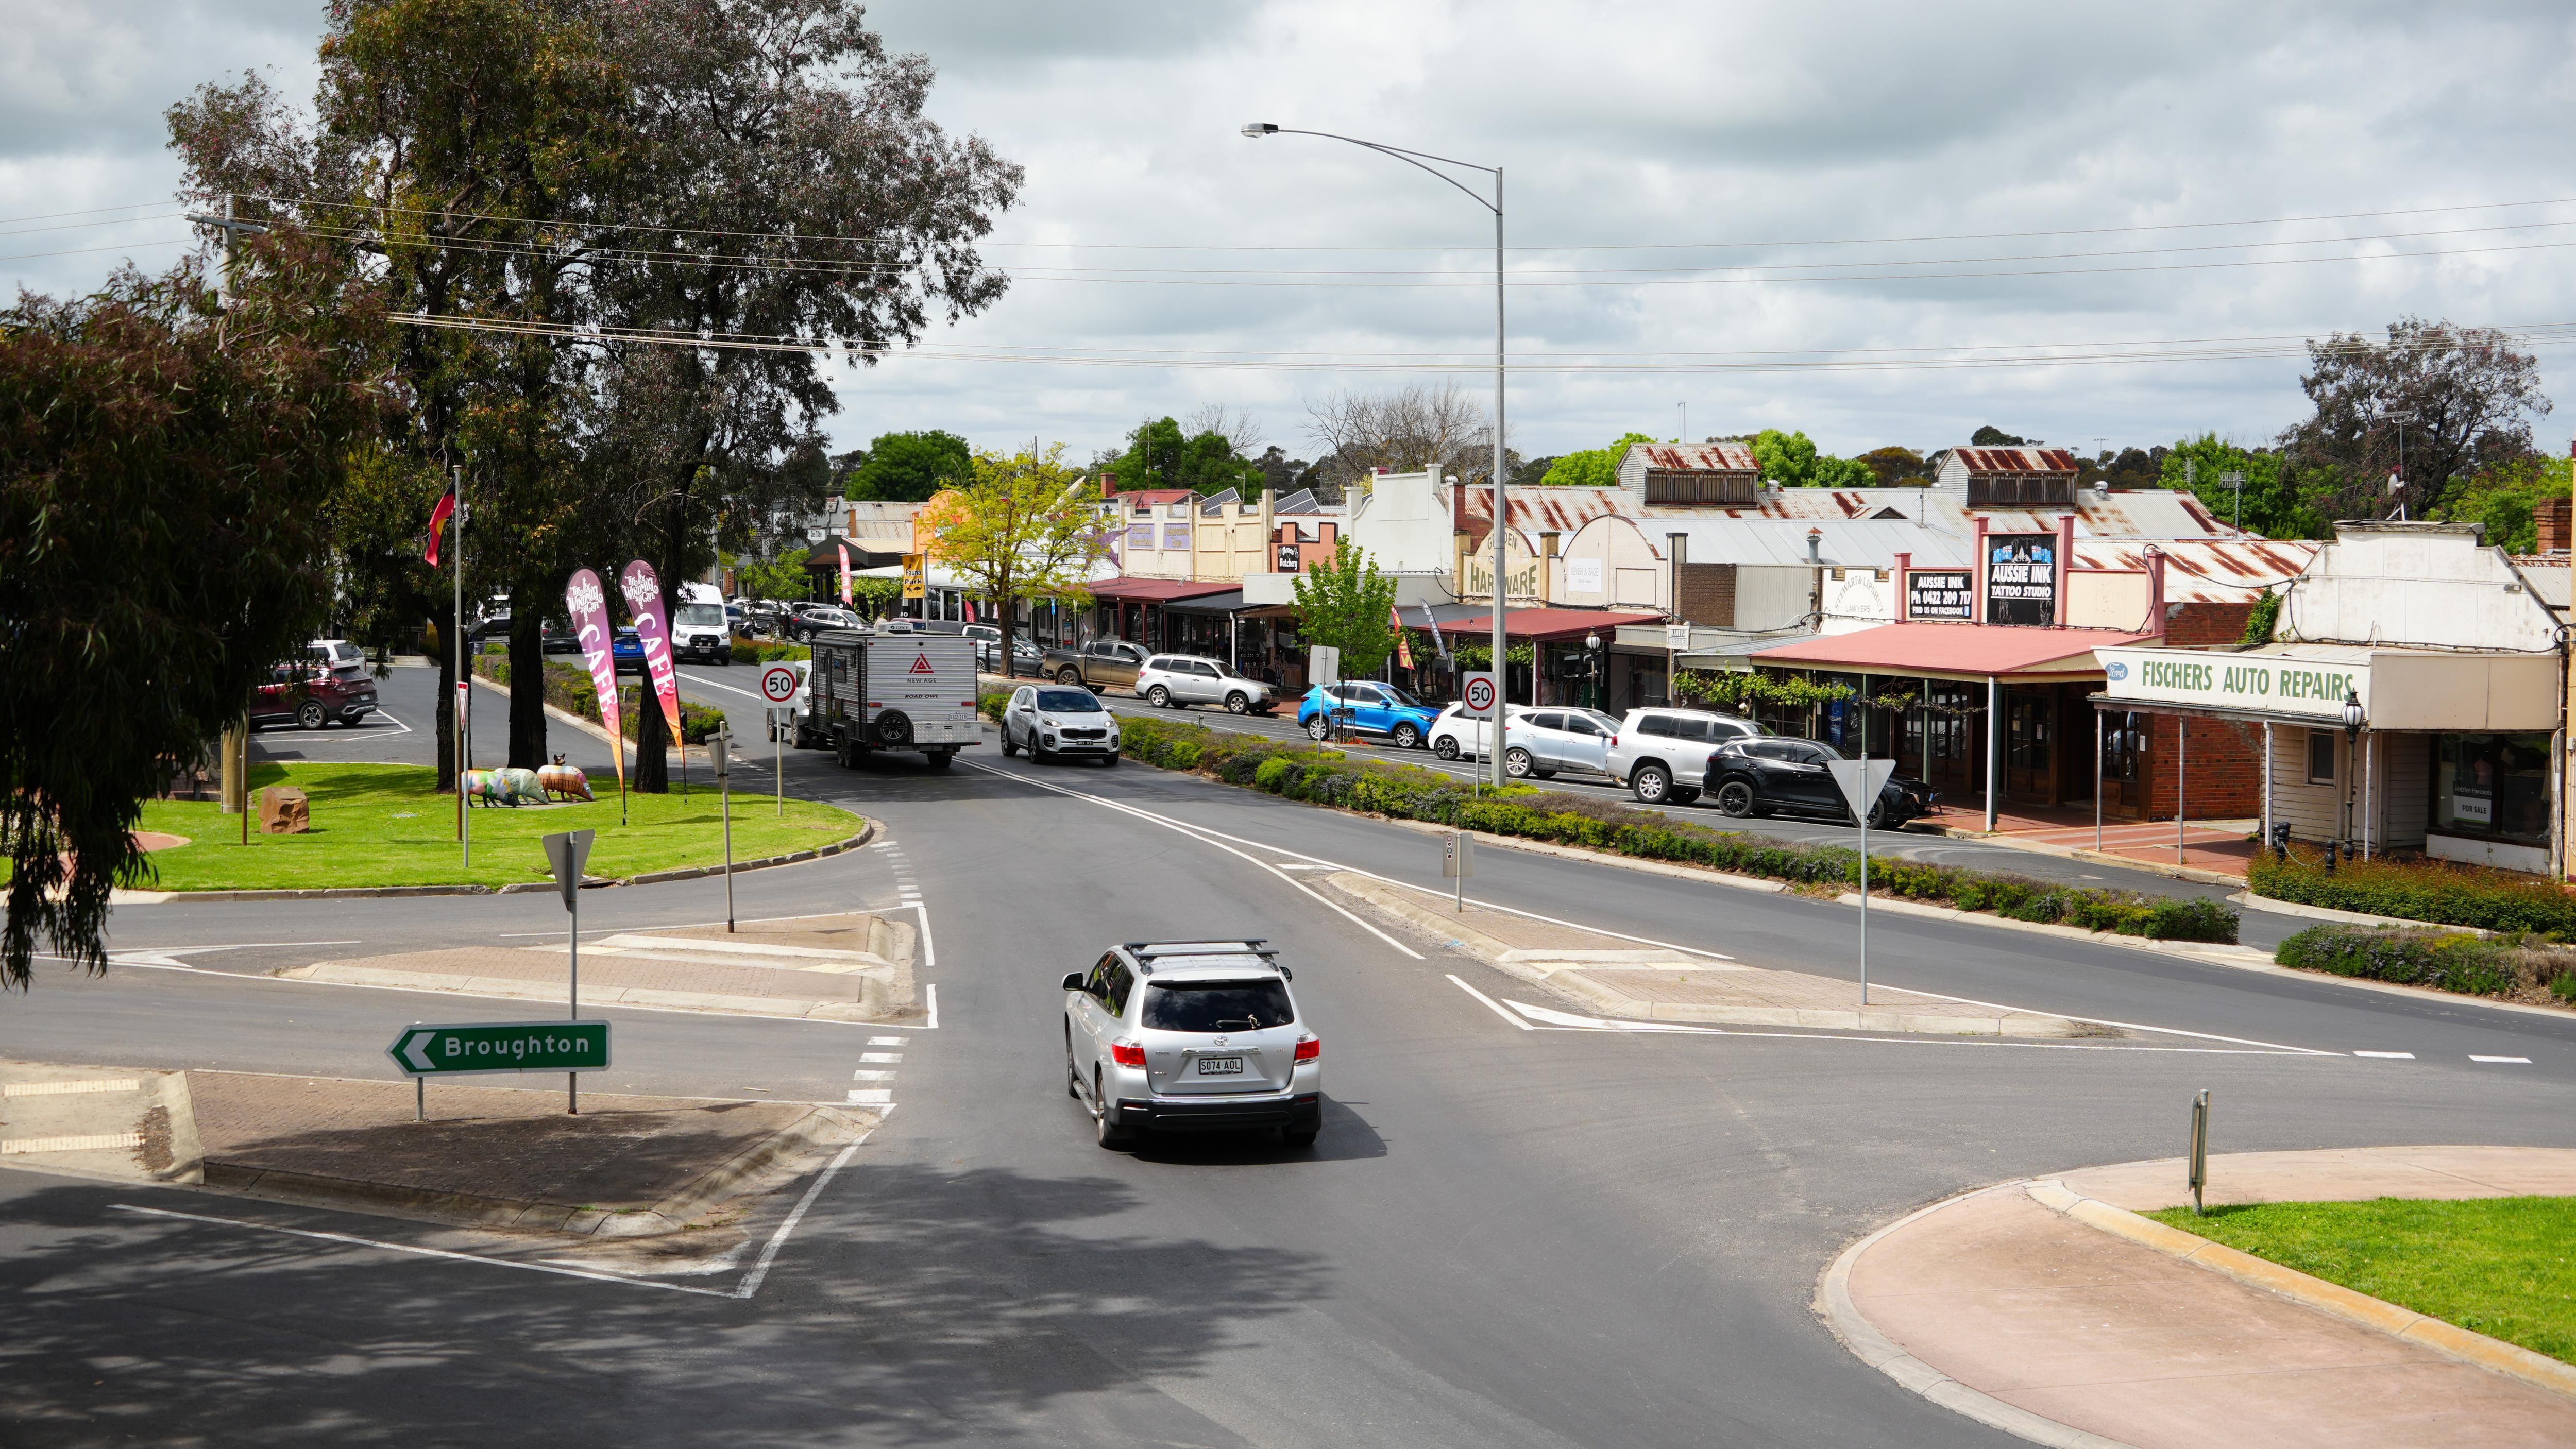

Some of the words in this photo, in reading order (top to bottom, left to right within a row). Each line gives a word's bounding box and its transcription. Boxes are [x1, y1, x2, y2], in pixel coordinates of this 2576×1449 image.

[1487, 532, 1517, 550] GDEN
[1280, 558, 1298, 570] Butchery
[1570, 567, 1583, 576] SEVEN
[1584, 567, 1587, 576] &
[1588, 567, 1599, 576] SAGE
[624, 575, 638, 586] THE
[1470, 562, 1537, 595] HARWARE
[1991, 565, 2029, 583] AUSSIE
[2031, 566, 2052, 583] INK
[622, 577, 659, 601] WINDMILL
[1917, 576, 1946, 588] AUSSIE
[1948, 576, 1964, 589] INK
[570, 586, 583, 595] THE
[1835, 575, 1857, 611] STEWART
[1858, 575, 1862, 585] &
[1911, 591, 1921, 604] Ph
[1923, 591, 1941, 604] 0422
[1943, 591, 1958, 605] 209
[1959, 591, 1972, 605] 717
[1991, 585, 2022, 596] TATTOO
[2023, 586, 2052, 598] STUDIO
[567, 585, 604, 613] WINDMILL
[634, 613, 676, 696] CAFE
[579, 624, 618, 713] CAFE
[2108, 663, 2125, 678] Ford
[769, 677, 790, 692] 50
[1913, 678, 1957, 691] Sudio
[2143, 661, 2213, 691] FISCHERS
[2223, 666, 2269, 695] AUTO
[2280, 670, 2353, 702] REPAIRS
[1471, 687, 1490, 701] 50
[2474, 806, 2487, 814] SALE
[445, 1035, 588, 1060] Broughton
